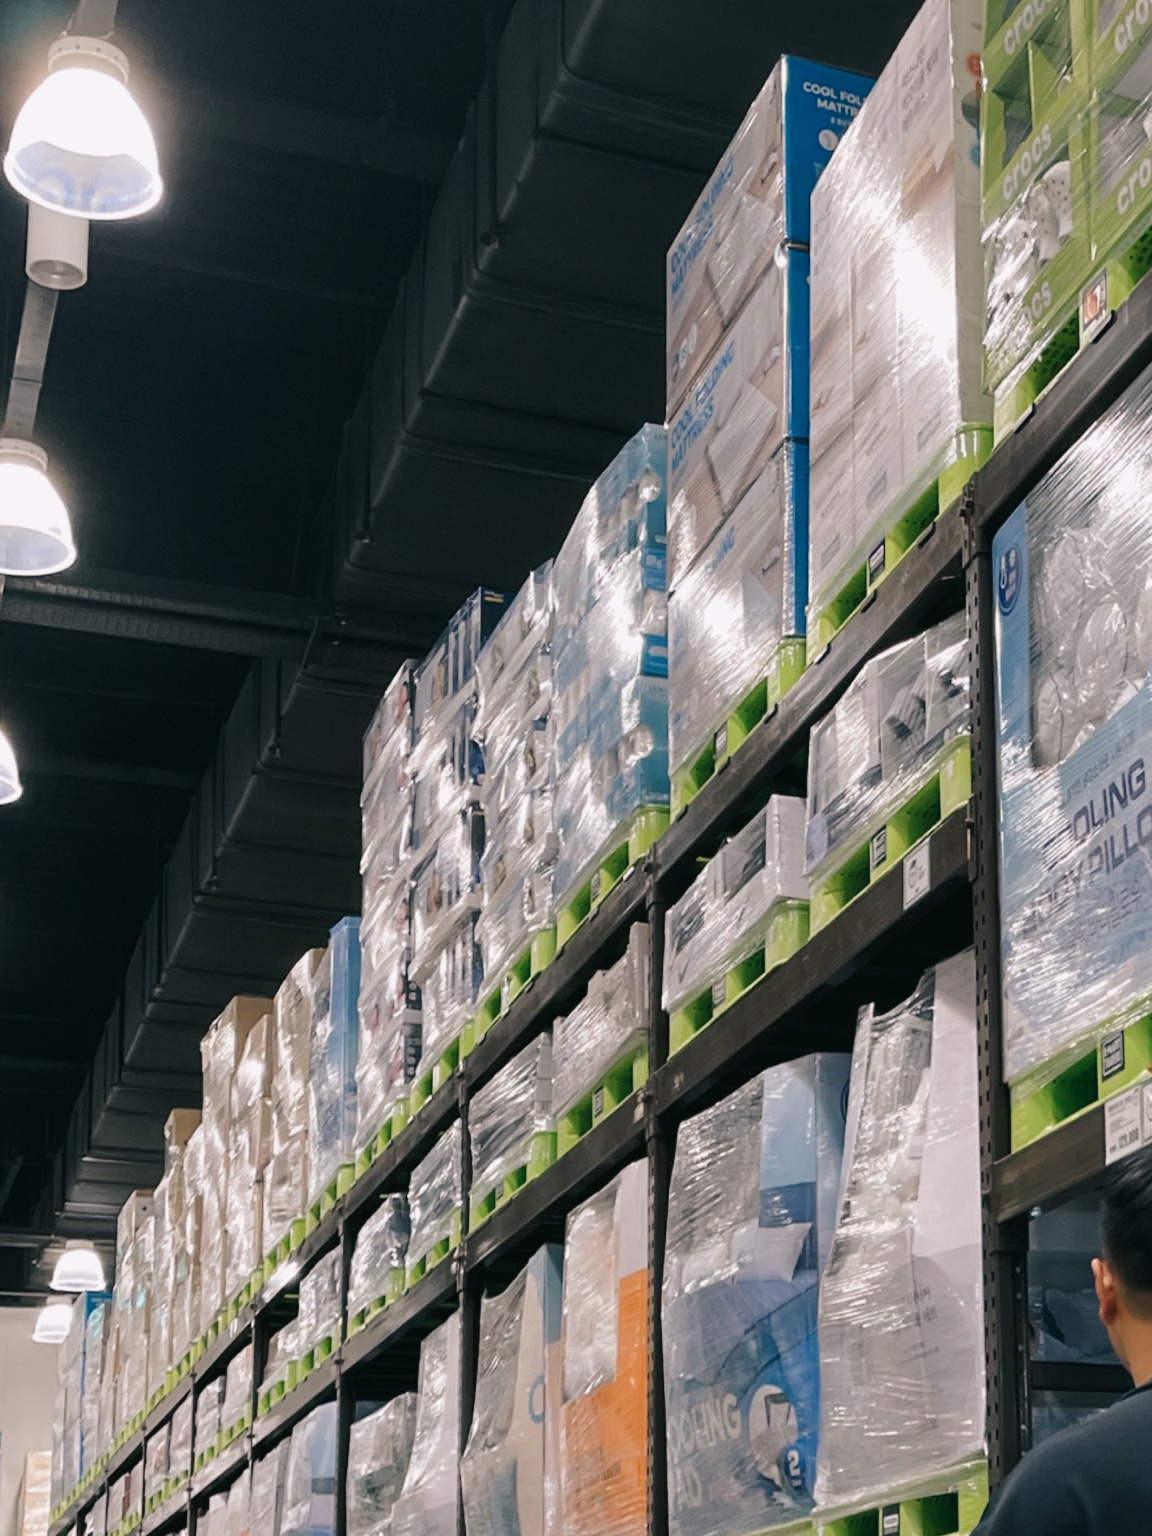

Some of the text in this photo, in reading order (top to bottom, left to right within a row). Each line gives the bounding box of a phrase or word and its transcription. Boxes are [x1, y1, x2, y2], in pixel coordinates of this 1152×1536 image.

[803, 81, 838, 100] COOL
[1003, 122, 1052, 200] crocs
[787, 1450, 800, 1476] 2
